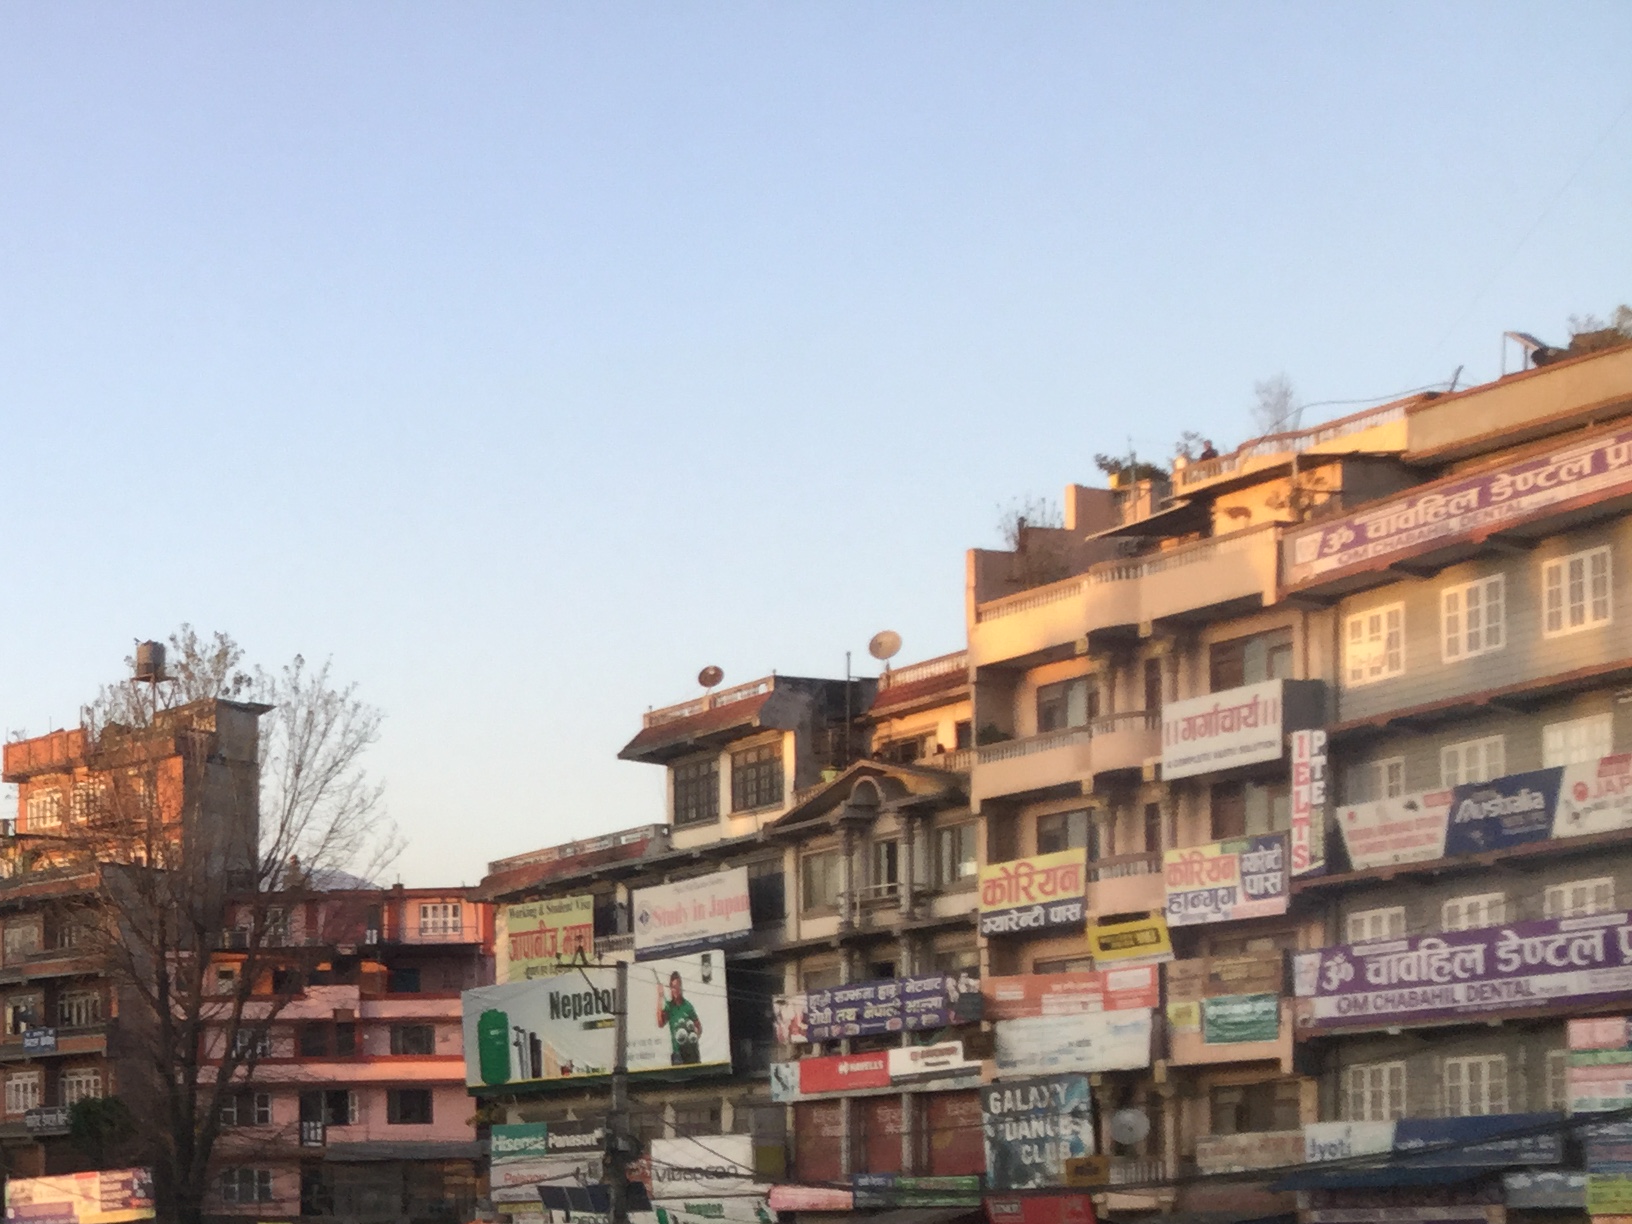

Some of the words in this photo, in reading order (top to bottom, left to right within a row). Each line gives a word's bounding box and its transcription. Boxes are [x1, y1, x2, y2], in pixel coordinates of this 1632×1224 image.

[1311, 730, 1327, 805] PTE
[1293, 735, 1311, 869] IELTS
[982, 861, 1082, 907] कोरियन
[509, 906, 537, 920] Working
[546, 902, 573, 915] Student
[652, 901, 688, 928] Study
[693, 897, 707, 922] in
[709, 895, 751, 922] Japan
[1467, 979, 1536, 1004] DENTAL
[989, 1083, 1069, 1114] GALAXY
[1021, 1141, 1072, 1165] CLUB
